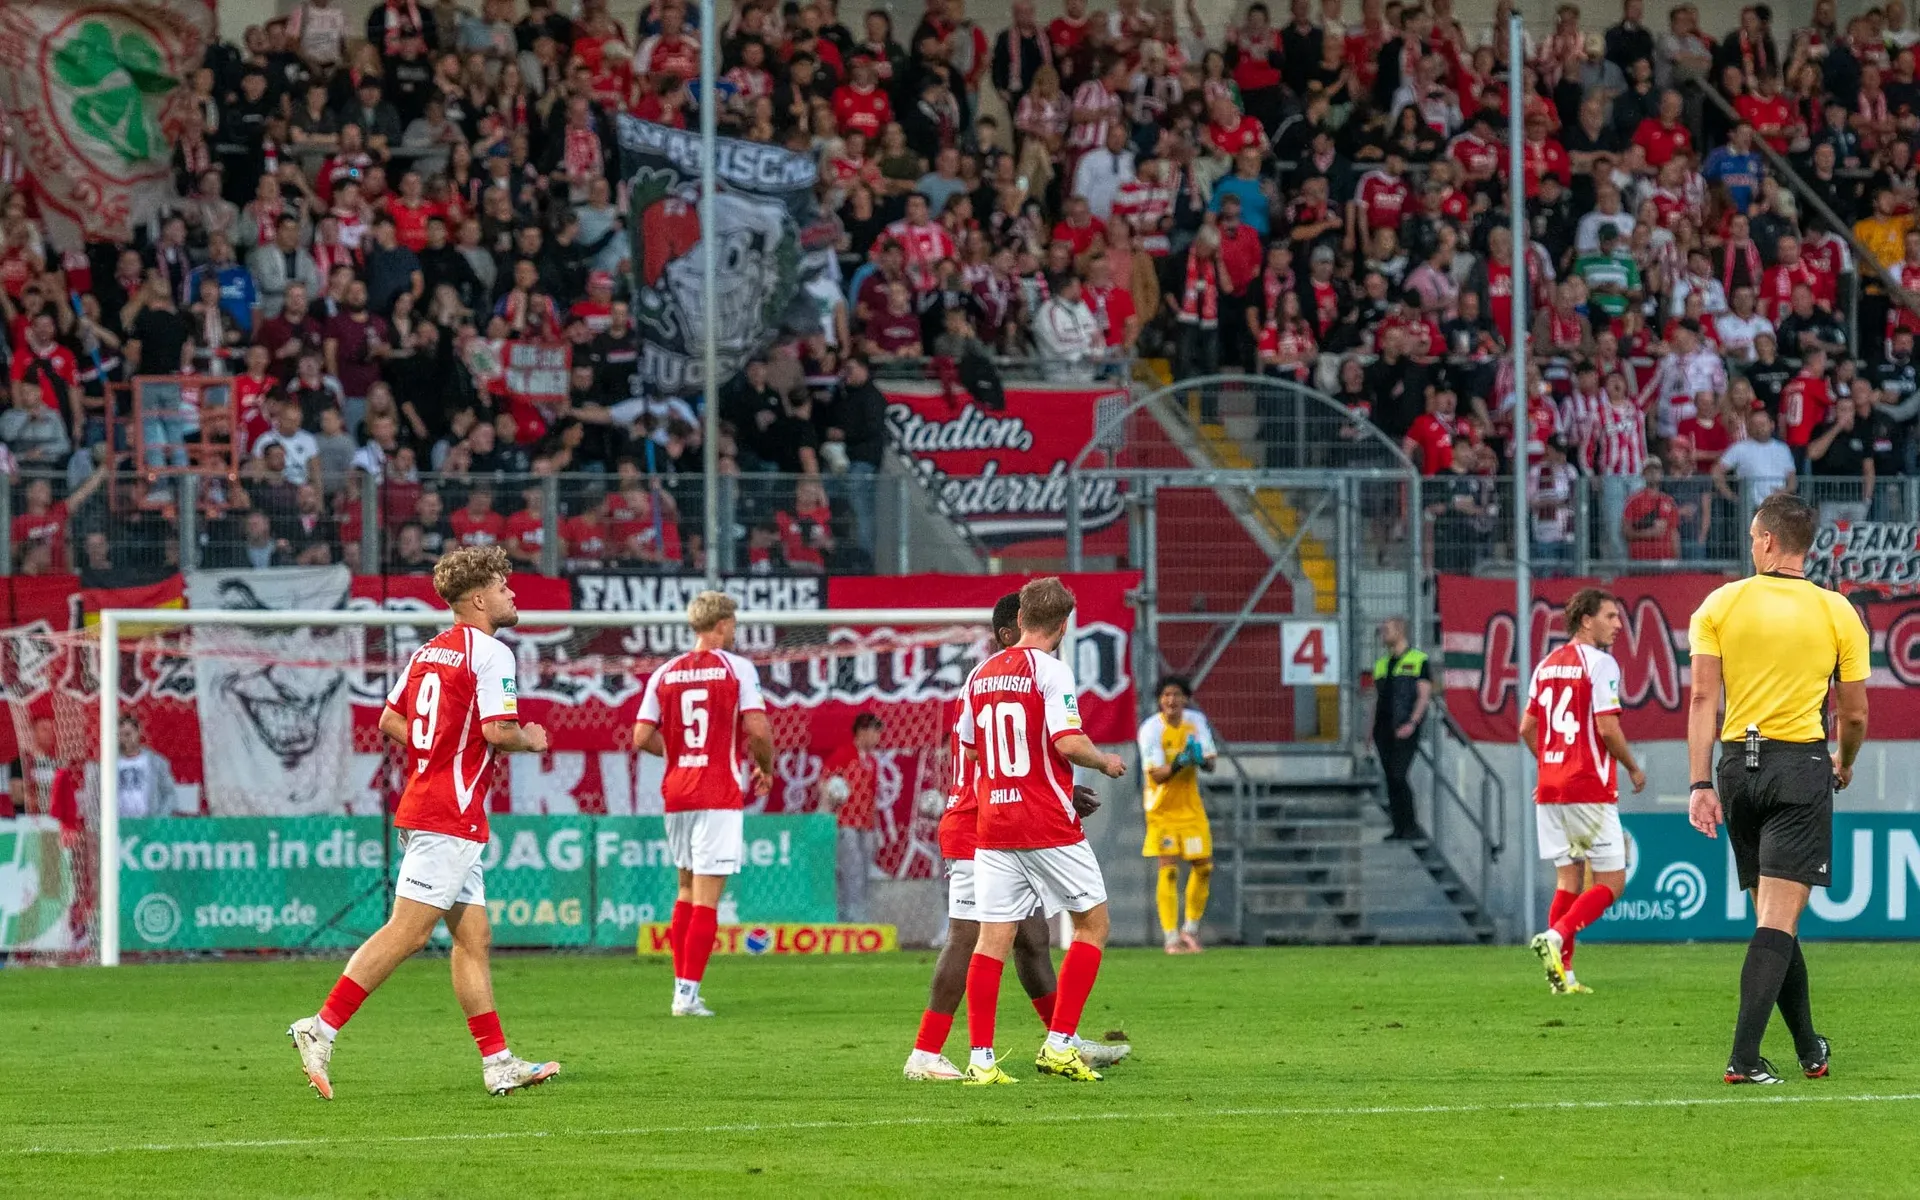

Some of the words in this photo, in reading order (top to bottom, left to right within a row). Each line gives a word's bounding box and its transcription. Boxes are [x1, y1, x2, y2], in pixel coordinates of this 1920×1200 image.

[1293, 629, 1330, 674] 4
[411, 672, 442, 750] 9
[681, 688, 709, 749] 5
[1538, 686, 1580, 746] 14
[976, 701, 1031, 780] 10
[118, 834, 257, 872] Komm
[267, 830, 310, 869] in
[314, 829, 384, 869] die
[410, 879, 433, 891] PATRICK
[194, 898, 318, 933] stoag.de
[488, 898, 583, 926] TOAG
[774, 926, 884, 954] LOTTO
